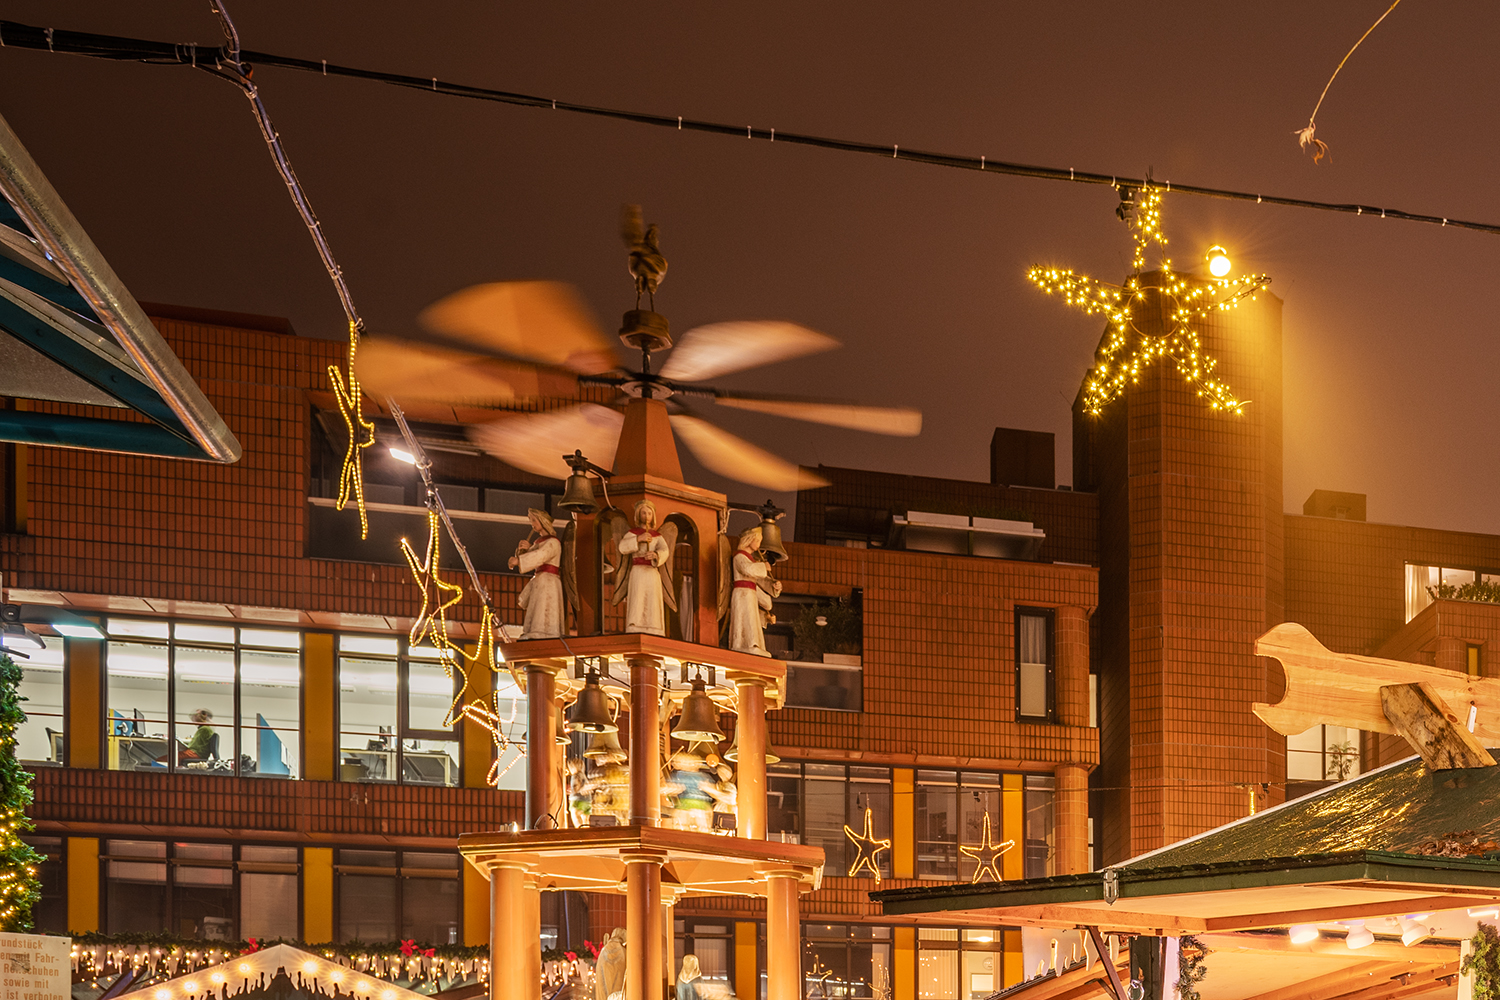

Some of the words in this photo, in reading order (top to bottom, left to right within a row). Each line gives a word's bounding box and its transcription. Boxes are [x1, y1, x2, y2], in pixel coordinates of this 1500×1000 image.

[0, 938, 43, 949] undstück
[35, 952, 60, 963] Fahr-
[3, 978, 30, 987] sowie
[34, 979, 49, 989] mit
[6, 990, 19, 1000] ist
